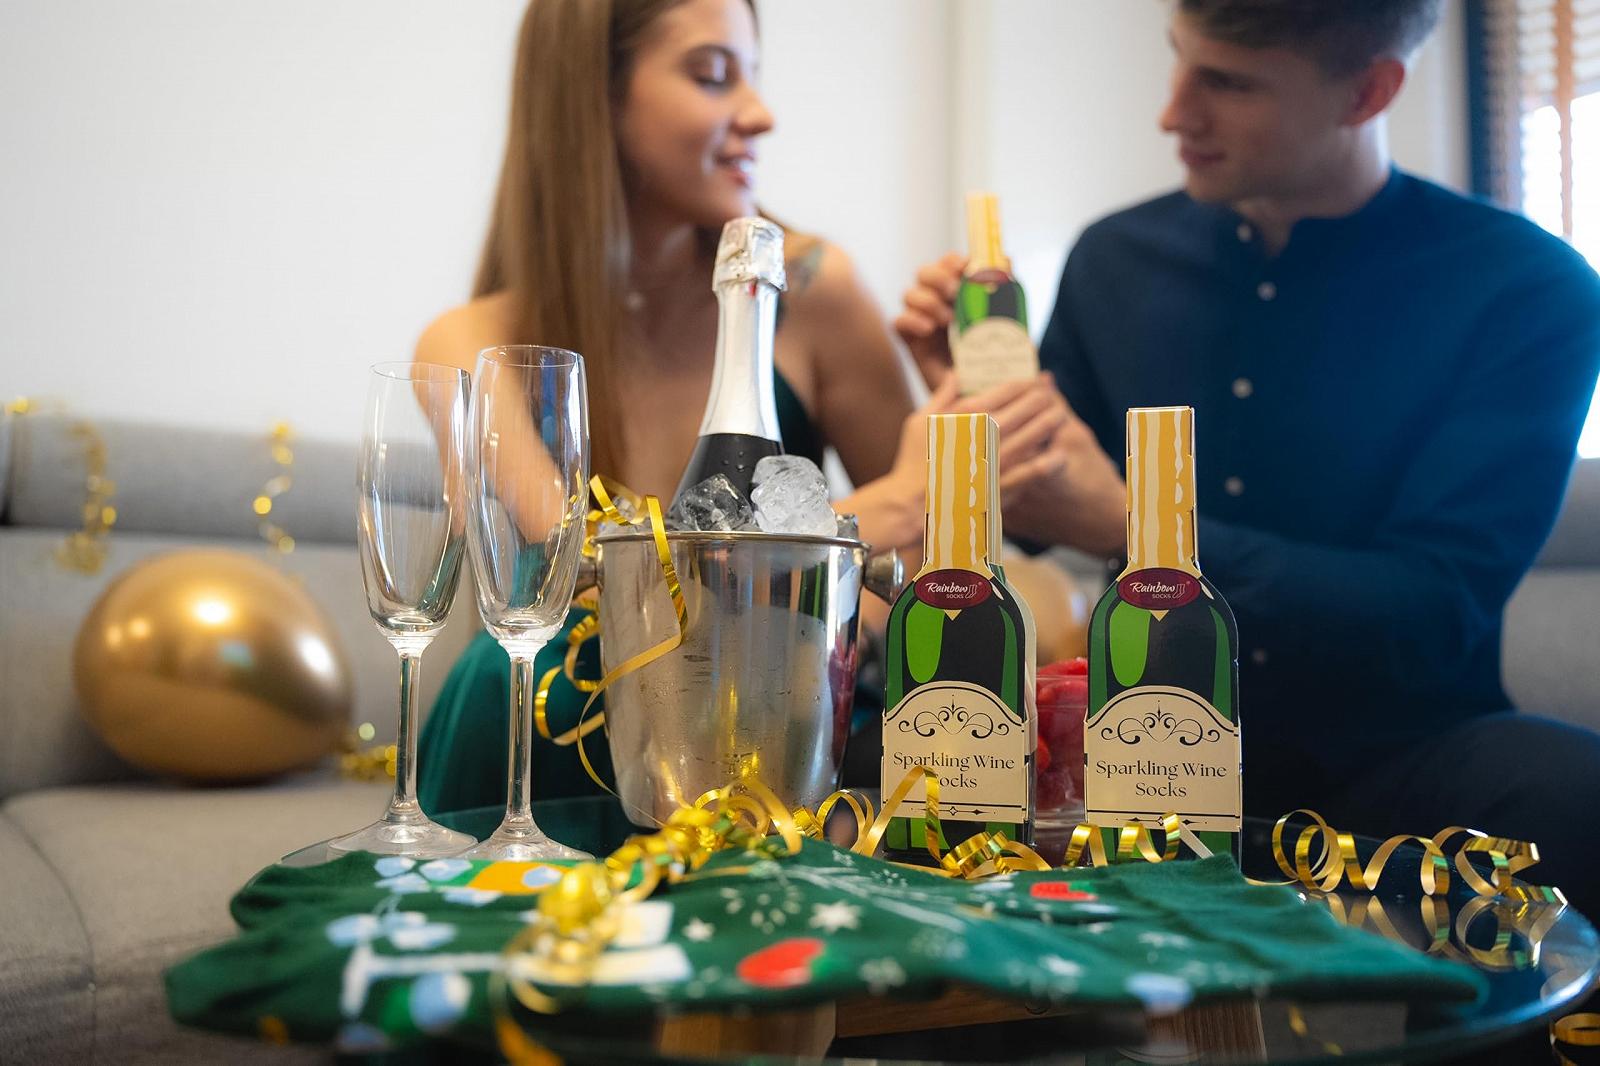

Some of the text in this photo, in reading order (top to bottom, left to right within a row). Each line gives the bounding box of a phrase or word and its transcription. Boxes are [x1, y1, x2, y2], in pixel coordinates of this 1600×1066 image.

[925, 581, 969, 593] Rainbow
[1129, 581, 1176, 593] Rainbow
[893, 751, 1015, 772] Sparkling Wine
[1095, 760, 1228, 780] Sparkling Wine
[936, 773, 978, 788] ocks
[1135, 781, 1187, 797] Socks
